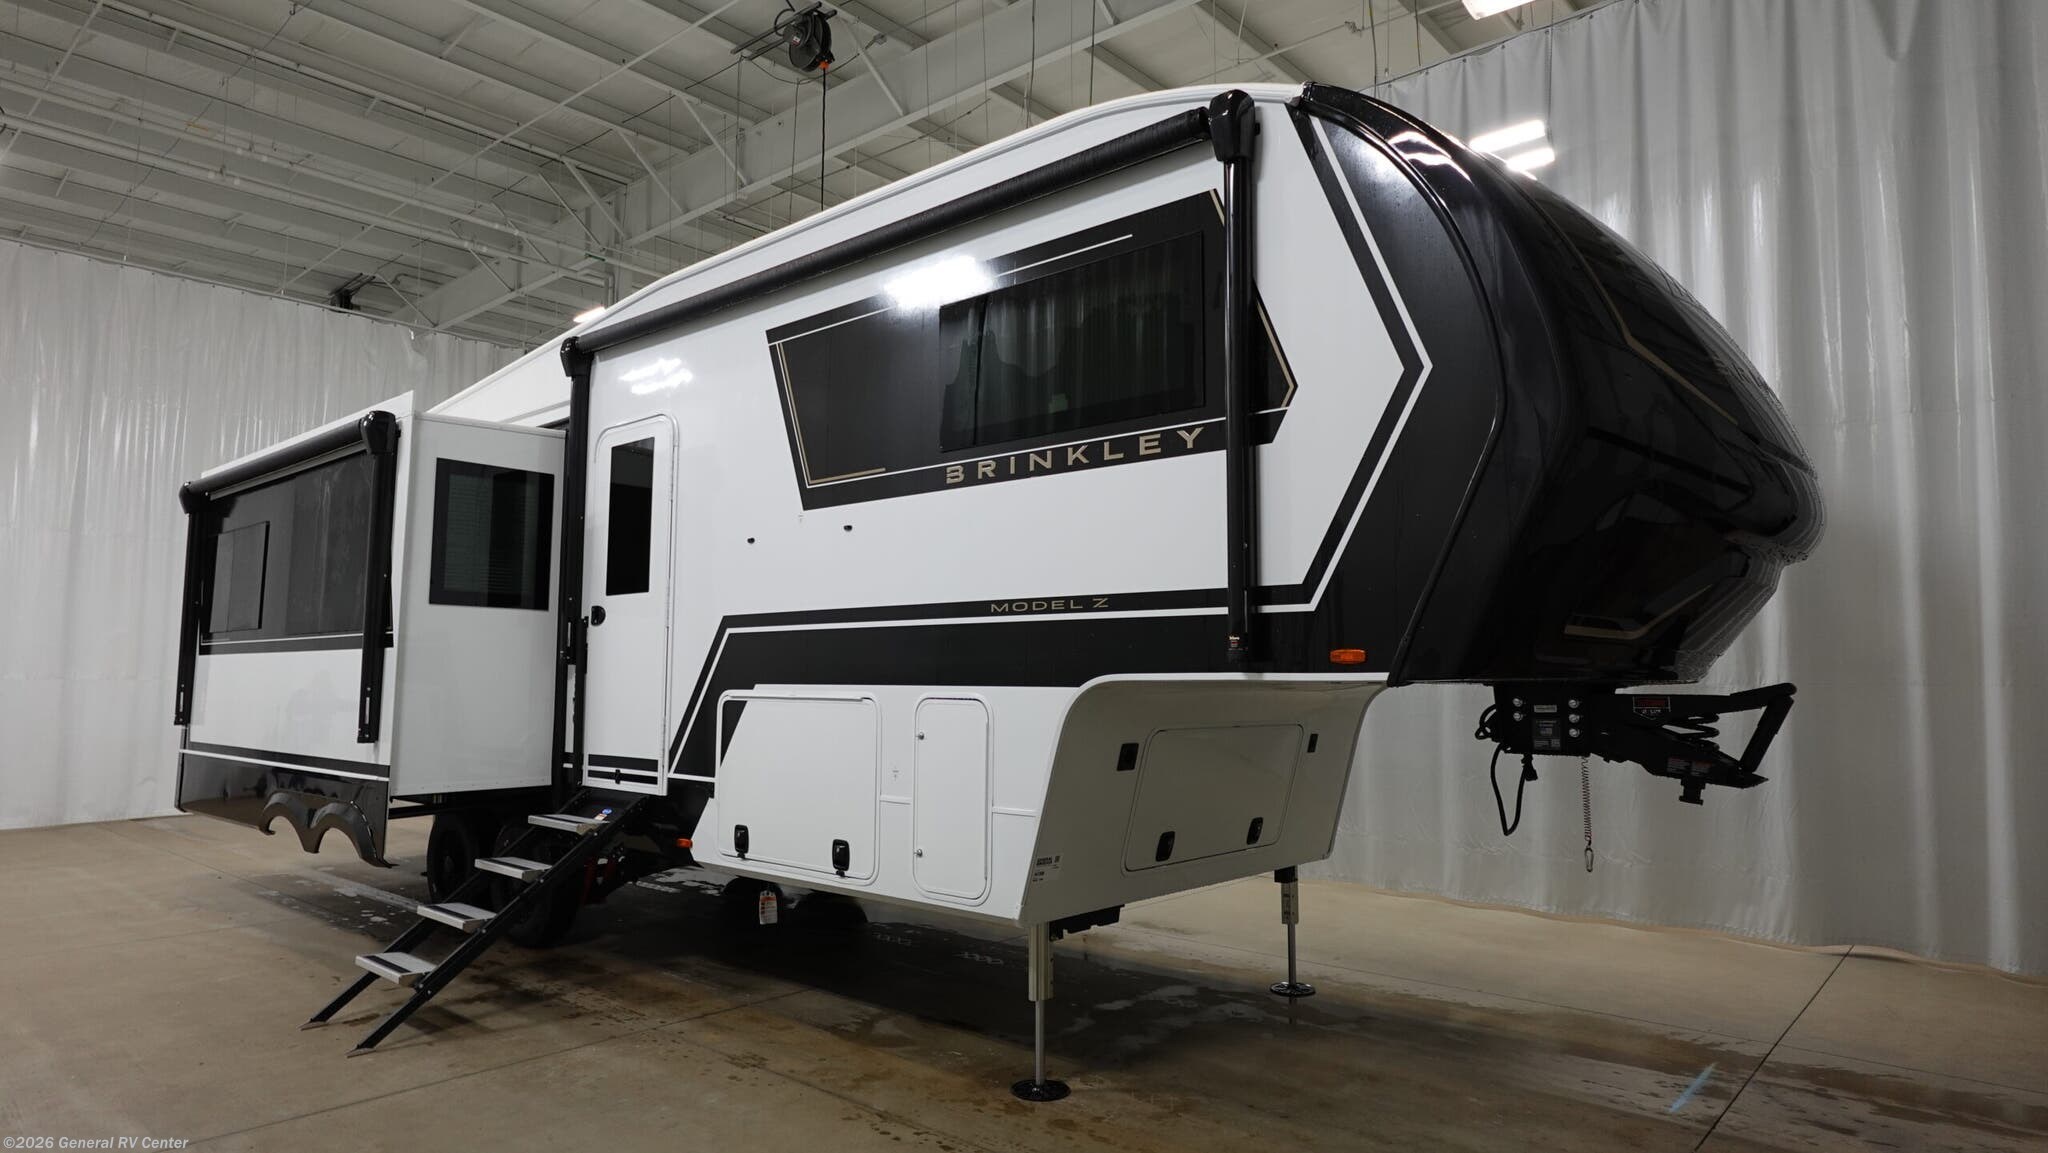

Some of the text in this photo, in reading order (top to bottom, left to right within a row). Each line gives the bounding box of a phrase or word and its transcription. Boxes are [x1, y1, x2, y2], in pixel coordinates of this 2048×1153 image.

[945, 427, 1204, 484] BRINKLEY
[990, 598, 1109, 612] MODEL Z
